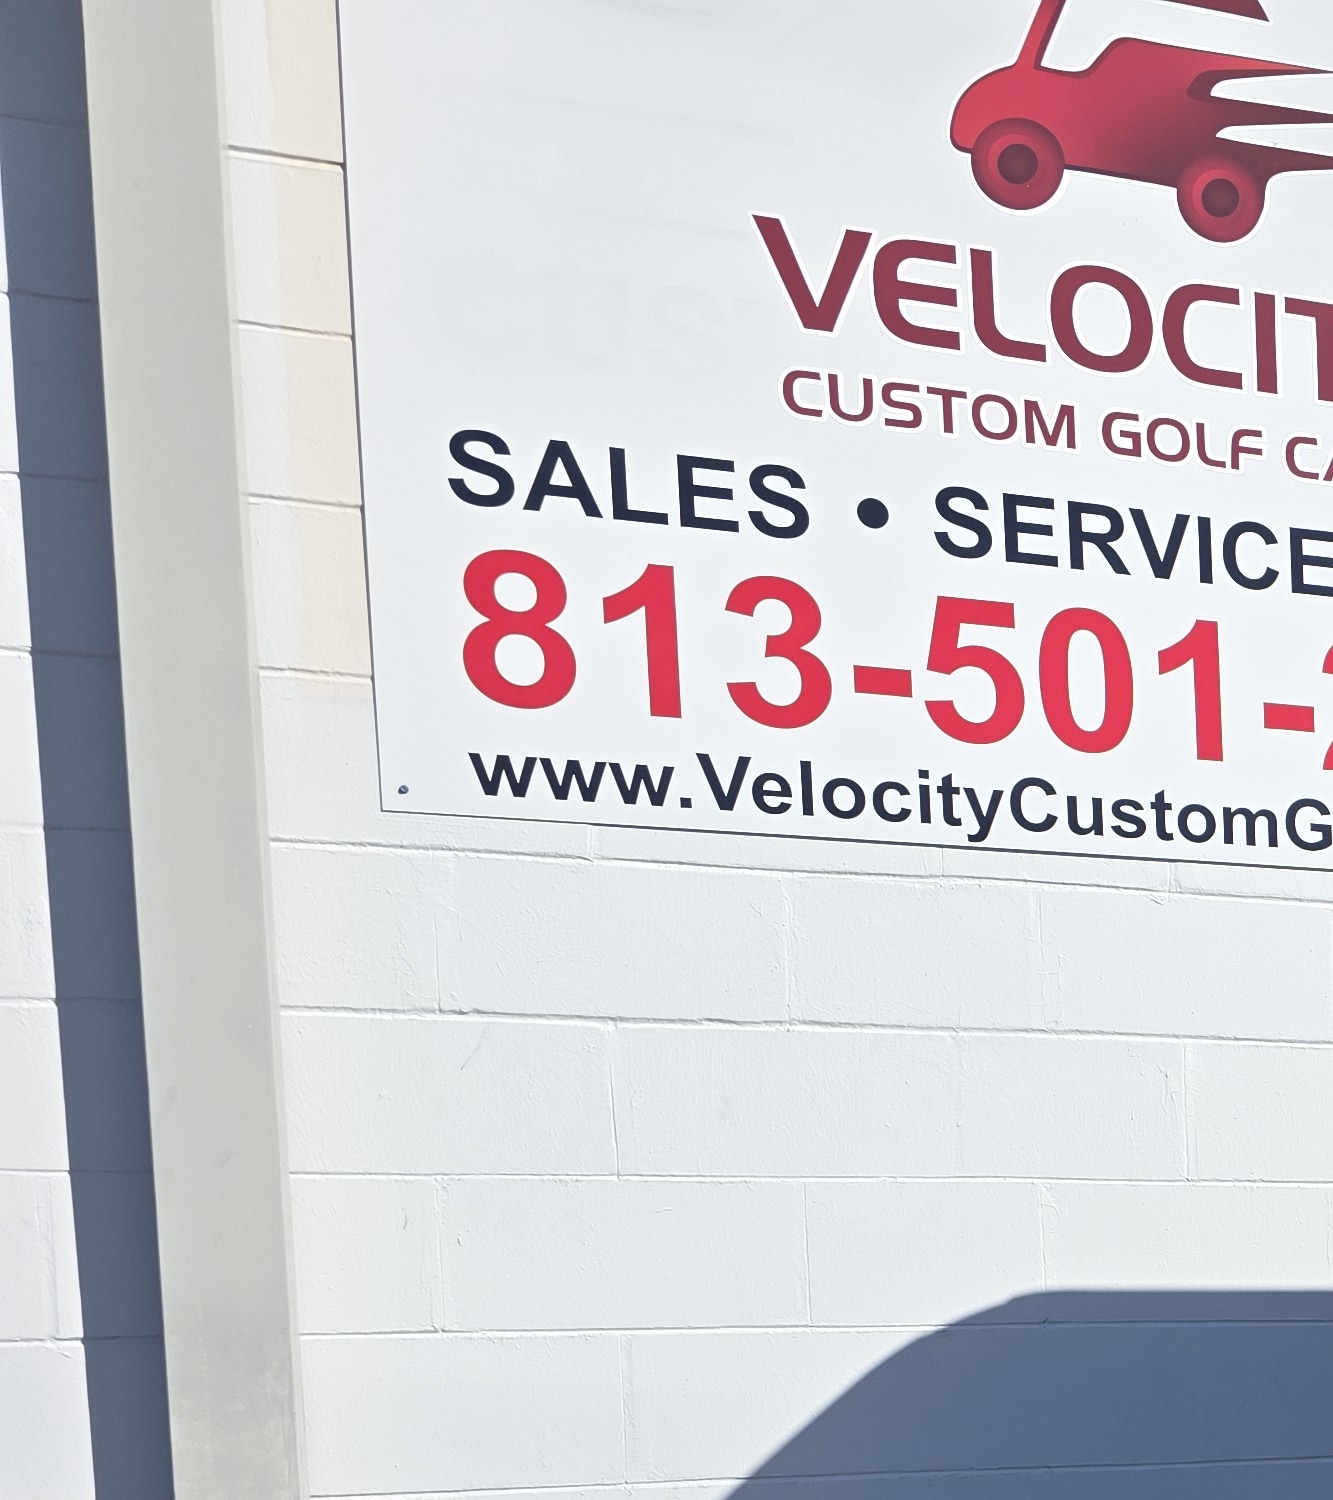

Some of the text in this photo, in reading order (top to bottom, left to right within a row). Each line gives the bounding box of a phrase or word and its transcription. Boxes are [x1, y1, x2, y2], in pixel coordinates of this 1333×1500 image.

[783, 371, 1076, 449] CUSTOM
[1102, 412, 1262, 470] GOLF
[448, 430, 809, 538] SALES
